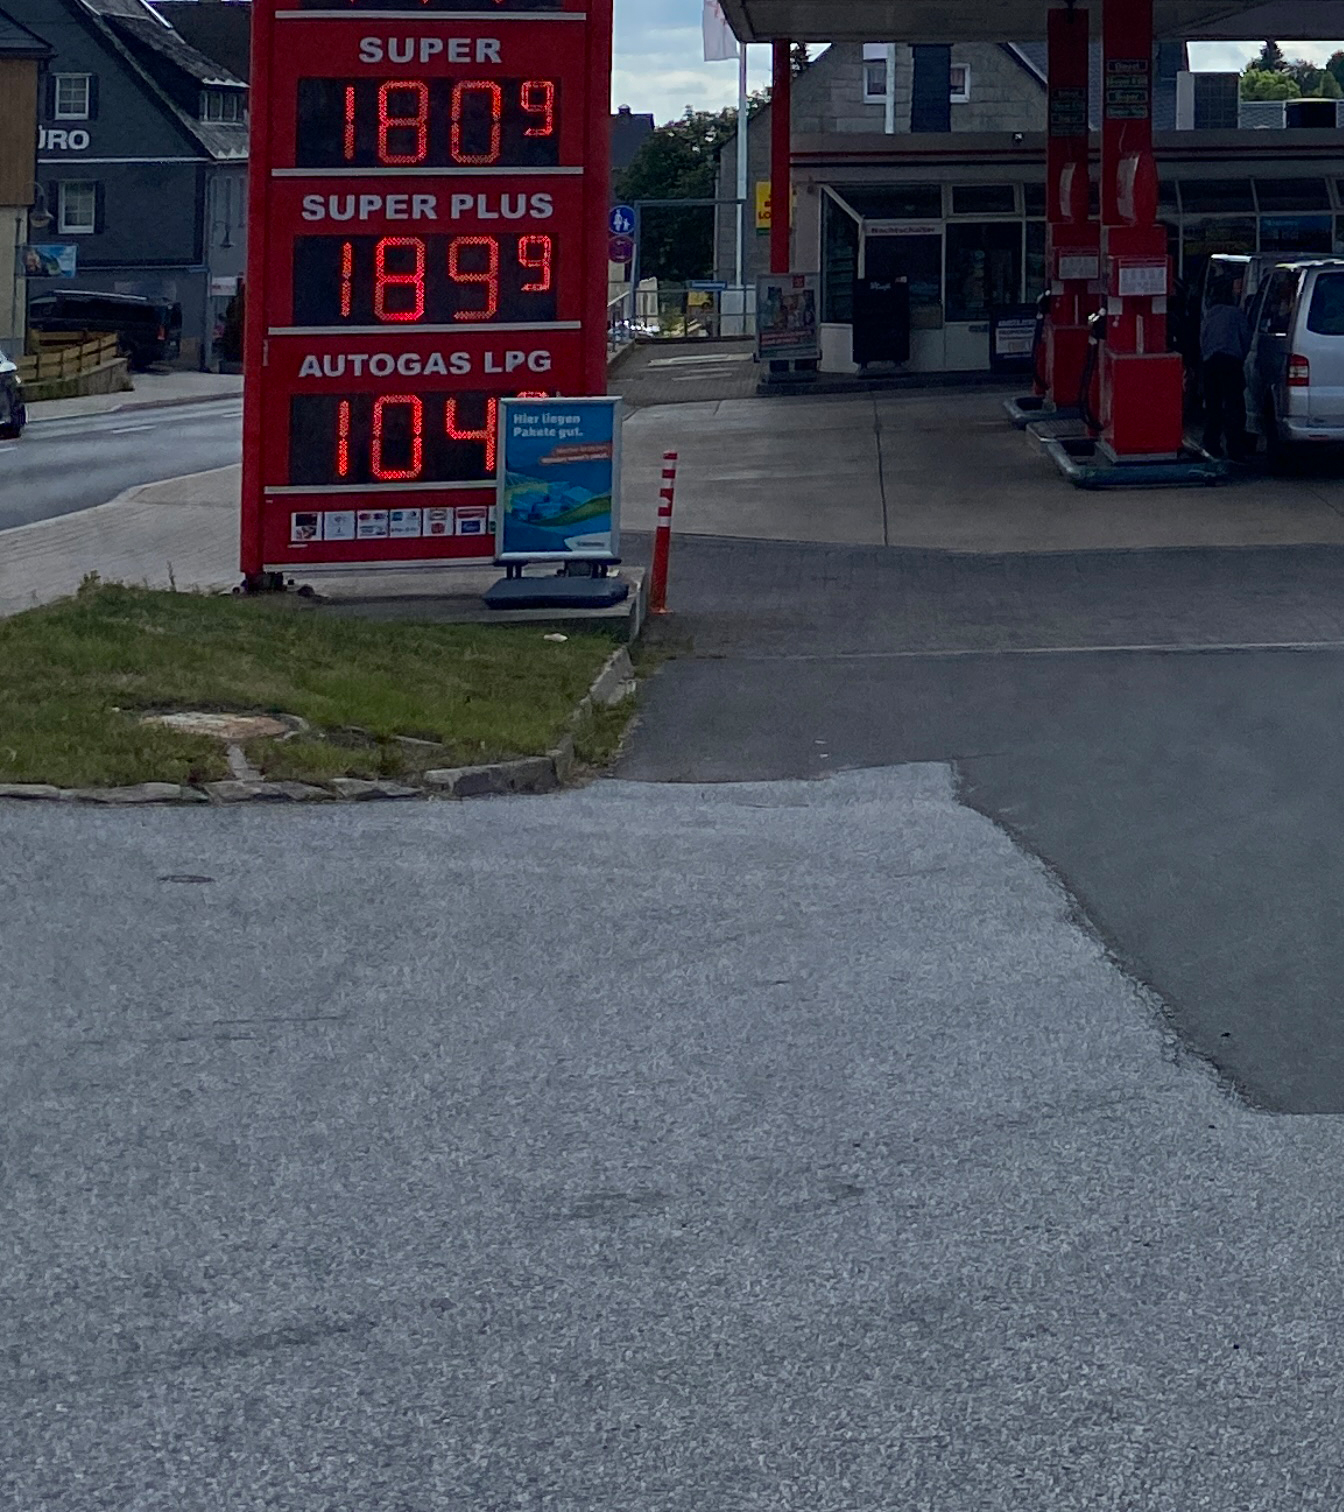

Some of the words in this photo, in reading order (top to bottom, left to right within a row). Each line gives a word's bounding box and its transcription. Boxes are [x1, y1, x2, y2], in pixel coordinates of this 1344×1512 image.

[358, 37, 502, 64] SUPER
[302, 194, 438, 221] SUPER
[450, 192, 554, 219] PLUS
[299, 352, 471, 378] AUTOGAS
[484, 350, 551, 374] LPG
[513, 413, 539, 425] Hier
[513, 426, 556, 437] Pakete
